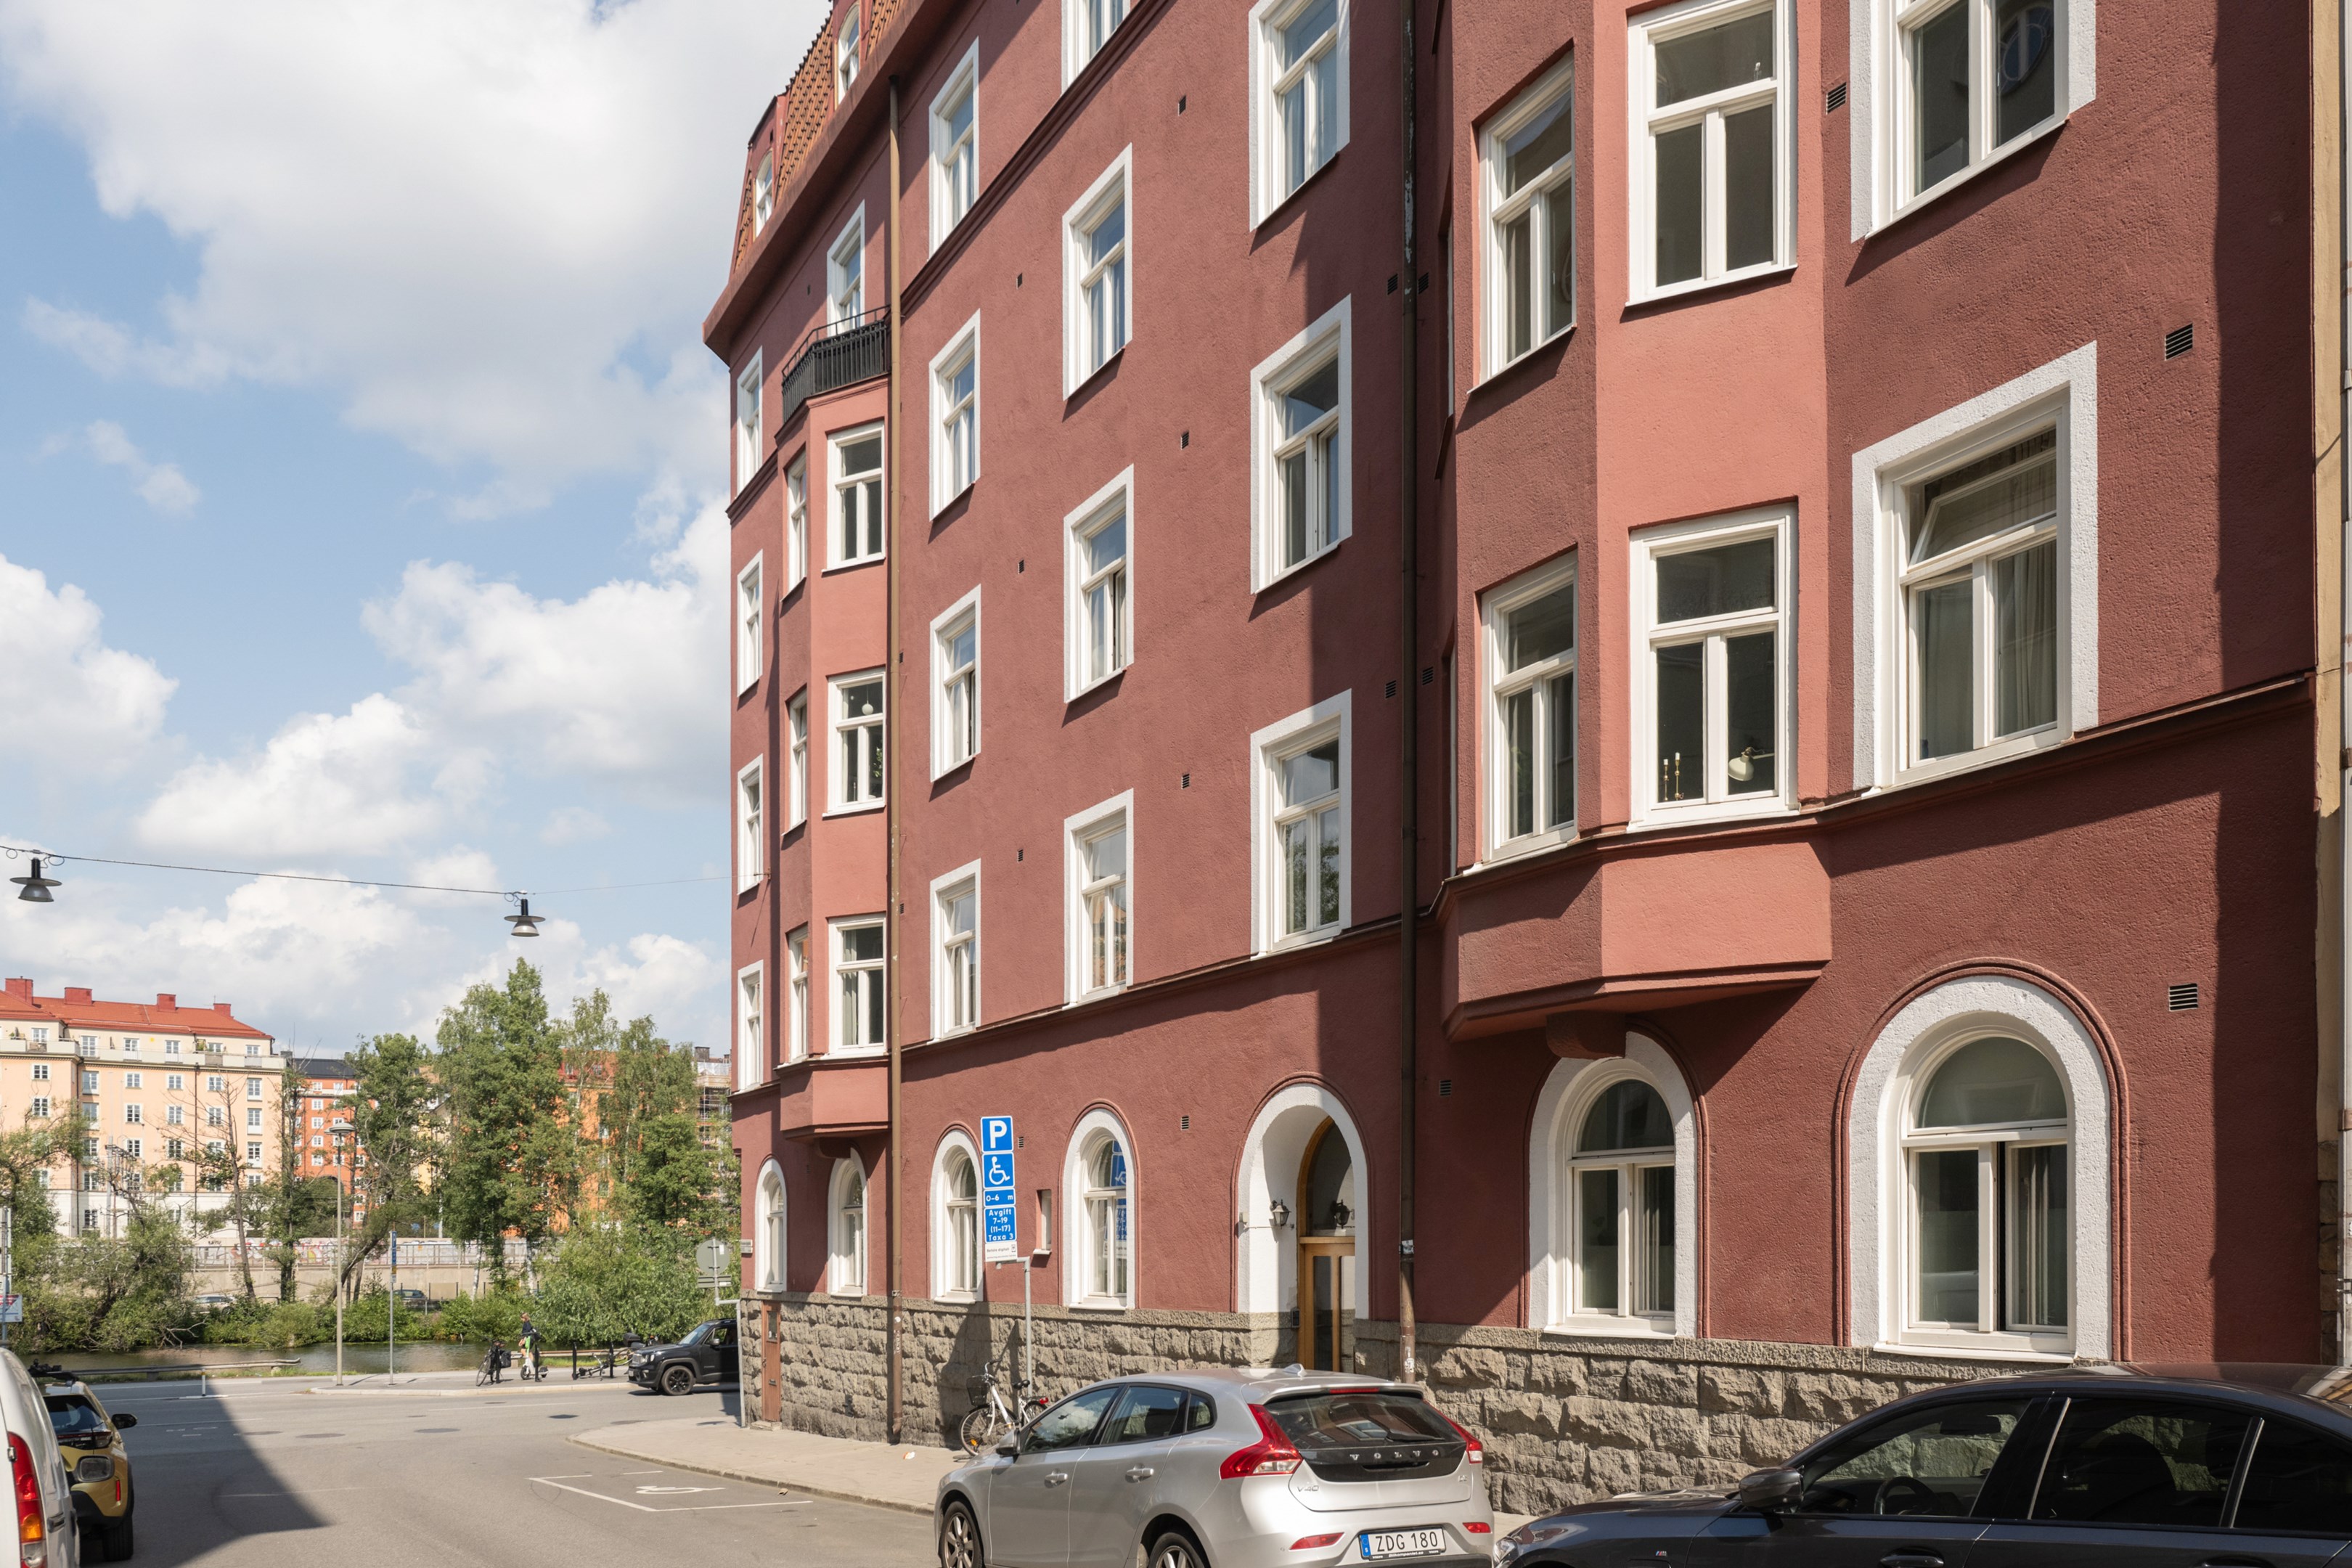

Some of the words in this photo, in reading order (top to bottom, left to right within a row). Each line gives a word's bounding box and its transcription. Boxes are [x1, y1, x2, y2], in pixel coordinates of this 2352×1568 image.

[989, 1120, 1007, 1148] P
[989, 1208, 1012, 1217] Avgift
[990, 1224, 1011, 1233] (11-17)
[1349, 1449, 1439, 1461] VOLVO
[1375, 1534, 1405, 1552] ZDG
[1410, 1531, 1438, 1548] 180
